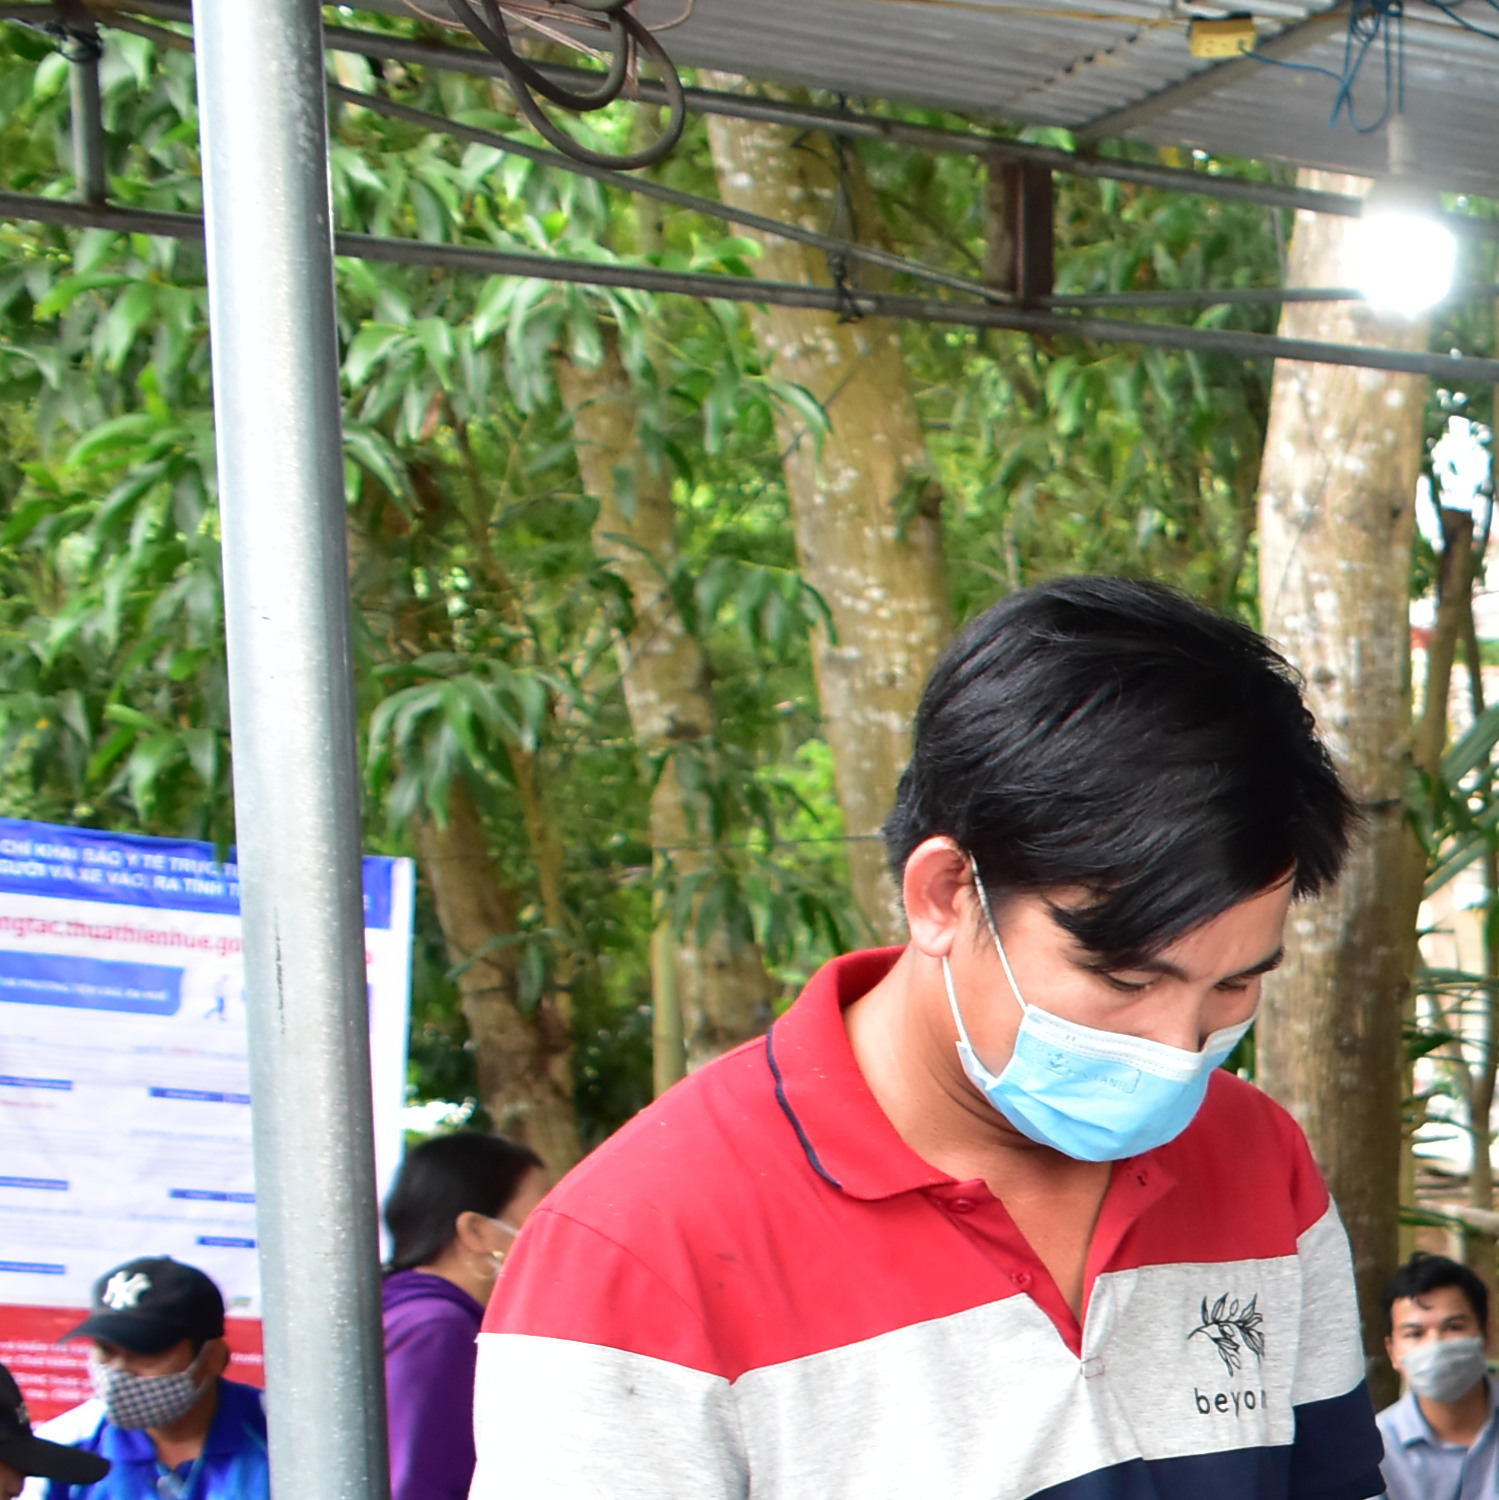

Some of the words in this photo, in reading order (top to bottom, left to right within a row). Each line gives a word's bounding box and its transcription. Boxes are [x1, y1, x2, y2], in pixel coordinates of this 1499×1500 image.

[35, 842, 77, 861] KHAI
[78, 867, 102, 883] XE
[153, 875, 181, 891] RA
